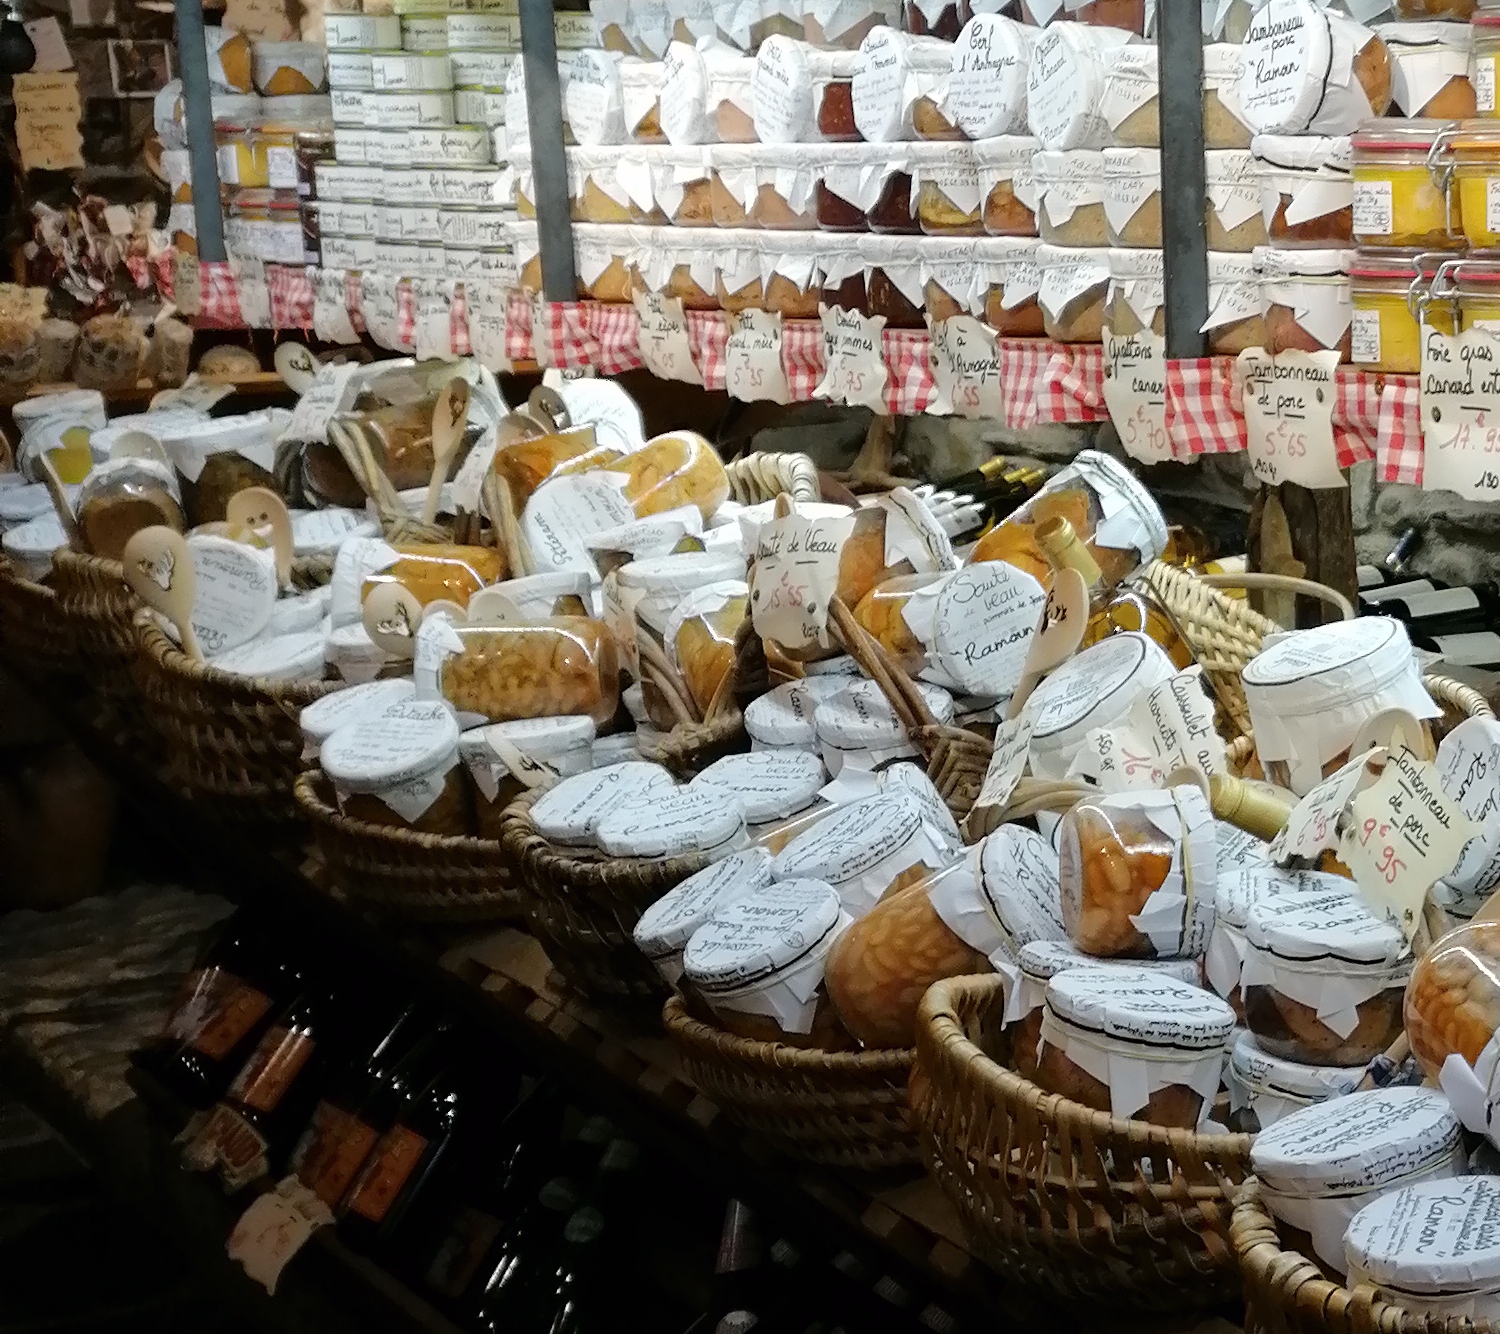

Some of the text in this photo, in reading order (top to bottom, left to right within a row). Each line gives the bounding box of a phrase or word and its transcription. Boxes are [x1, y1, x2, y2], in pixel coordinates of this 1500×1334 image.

[1426, 332, 1452, 362] Foie
[1246, 356, 1330, 383] Jambonneau
[1424, 367, 1474, 395] Canard
[1132, 377, 1166, 394] canar
[1386, 744, 1450, 830] Jambonneau
[1388, 791, 1431, 847] de porc
